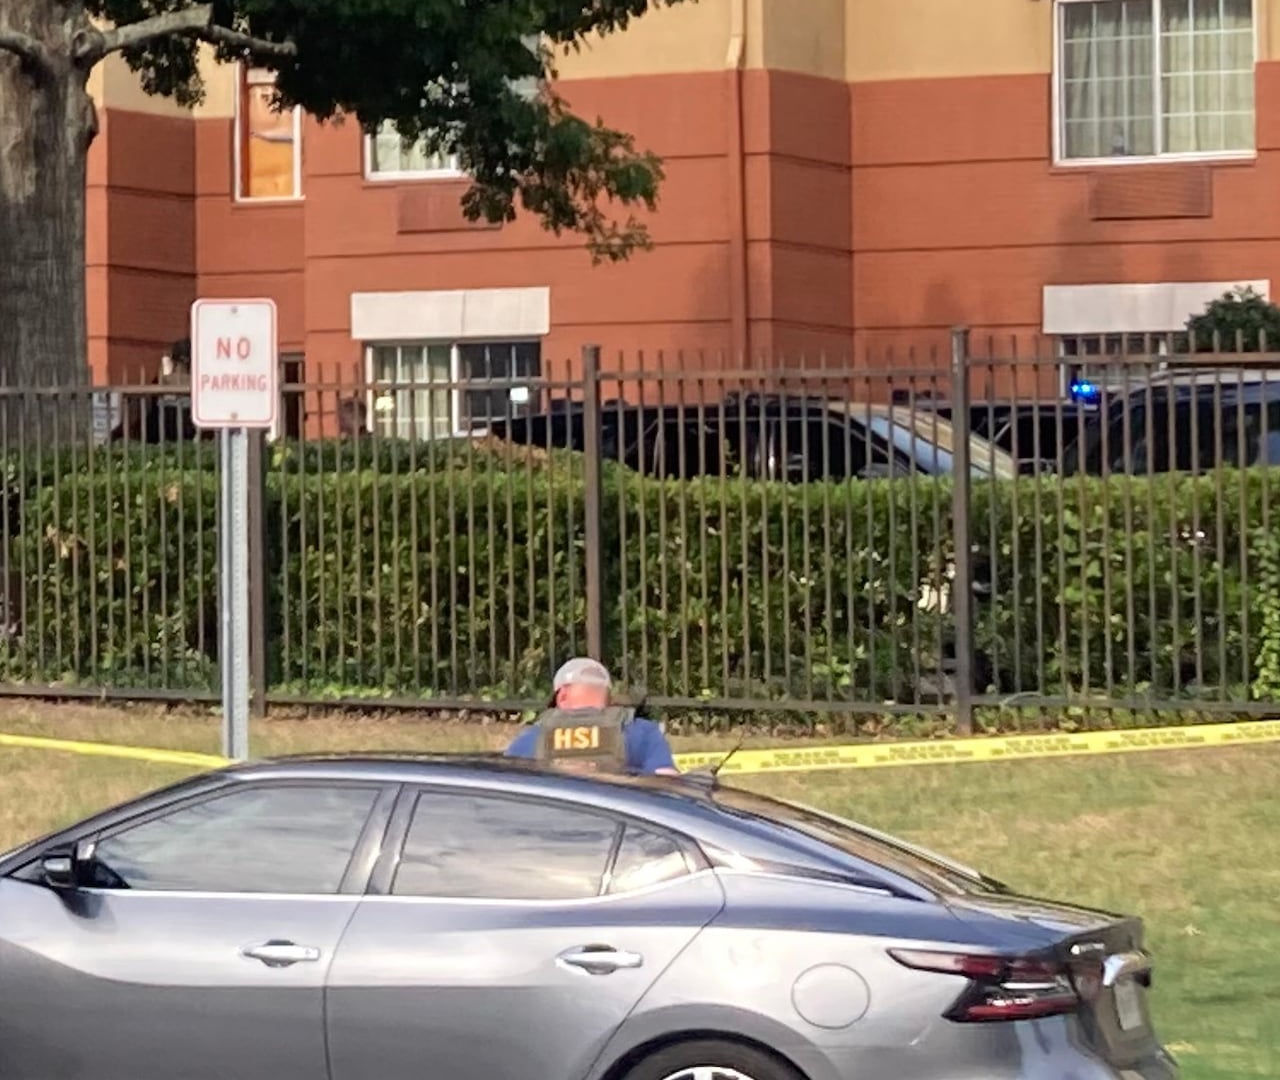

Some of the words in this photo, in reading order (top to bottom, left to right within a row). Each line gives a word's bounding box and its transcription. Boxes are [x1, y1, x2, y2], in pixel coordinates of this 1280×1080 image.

[215, 336, 252, 360] NO
[200, 373, 268, 393] PARKING
[553, 725, 600, 751] HSI
